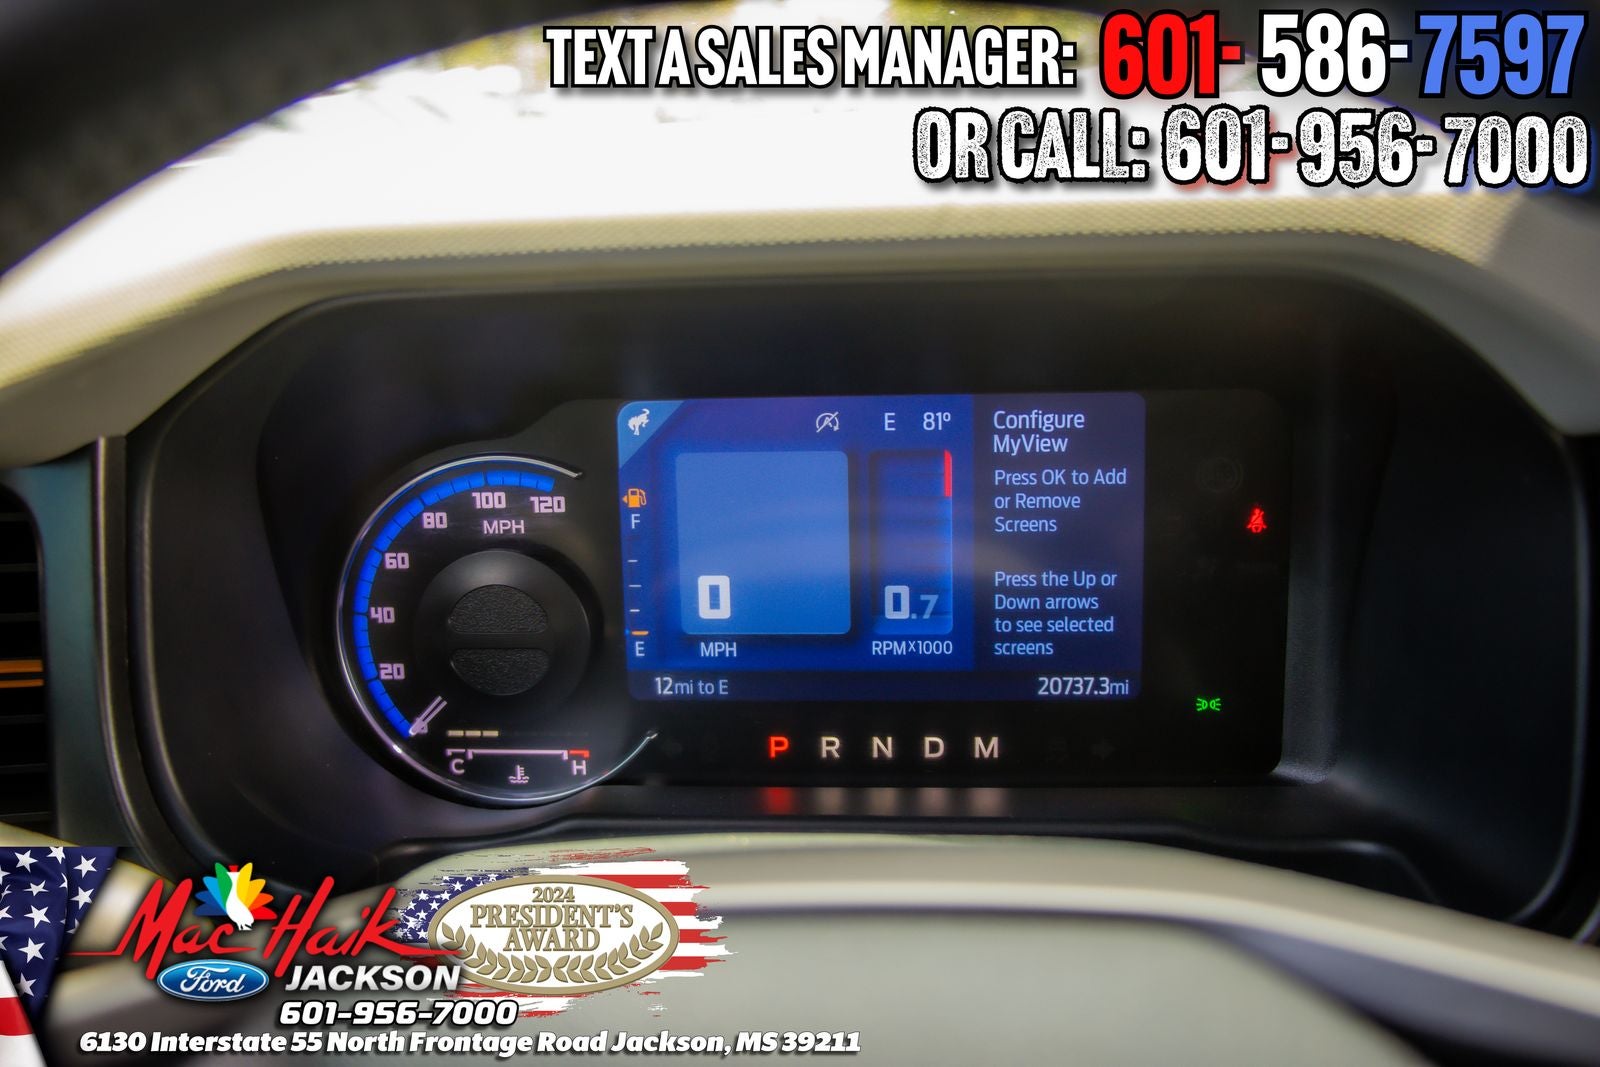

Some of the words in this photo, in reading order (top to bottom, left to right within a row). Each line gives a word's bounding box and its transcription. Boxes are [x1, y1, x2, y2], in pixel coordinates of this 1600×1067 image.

[883, 411, 897, 432] E
[993, 410, 1085, 432] Configure
[993, 434, 1068, 456] MyView
[994, 469, 1038, 486] Press
[1041, 469, 1066, 485] OK
[1071, 470, 1089, 485] to
[1093, 468, 1127, 485] Add
[471, 492, 507, 509] 100
[529, 496, 567, 513] 120
[994, 496, 1011, 509] or
[1015, 493, 1081, 509] Remove
[422, 512, 448, 529] 80
[483, 521, 525, 535] MPH
[630, 514, 641, 529] F
[994, 516, 1058, 532] Screens
[385, 553, 410, 569] 60
[994, 571, 1038, 587] Press
[1041, 571, 1069, 587] the
[1073, 571, 1096, 589] Up
[1101, 573, 1118, 586] or
[697, 575, 731, 619] 0
[884, 585, 940, 620] 0.7
[994, 594, 1040, 610] Down
[1045, 596, 1099, 609] arrows
[370, 607, 395, 623] 40
[994, 617, 1012, 632] to
[1016, 619, 1043, 632] see
[1046, 616, 1115, 633] selected
[635, 641, 645, 657] E
[700, 641, 738, 658] MPH
[993, 643, 1054, 655] screens
[379, 664, 405, 680] 20
[697, 680, 715, 695] to
[719, 680, 729, 695] E
[768, 736, 789, 758] P
[821, 736, 841, 758] R
[872, 736, 893, 758] N
[924, 736, 945, 758] D
[974, 736, 999, 758] M
[451, 759, 465, 775] C
[572, 759, 588, 775] H
